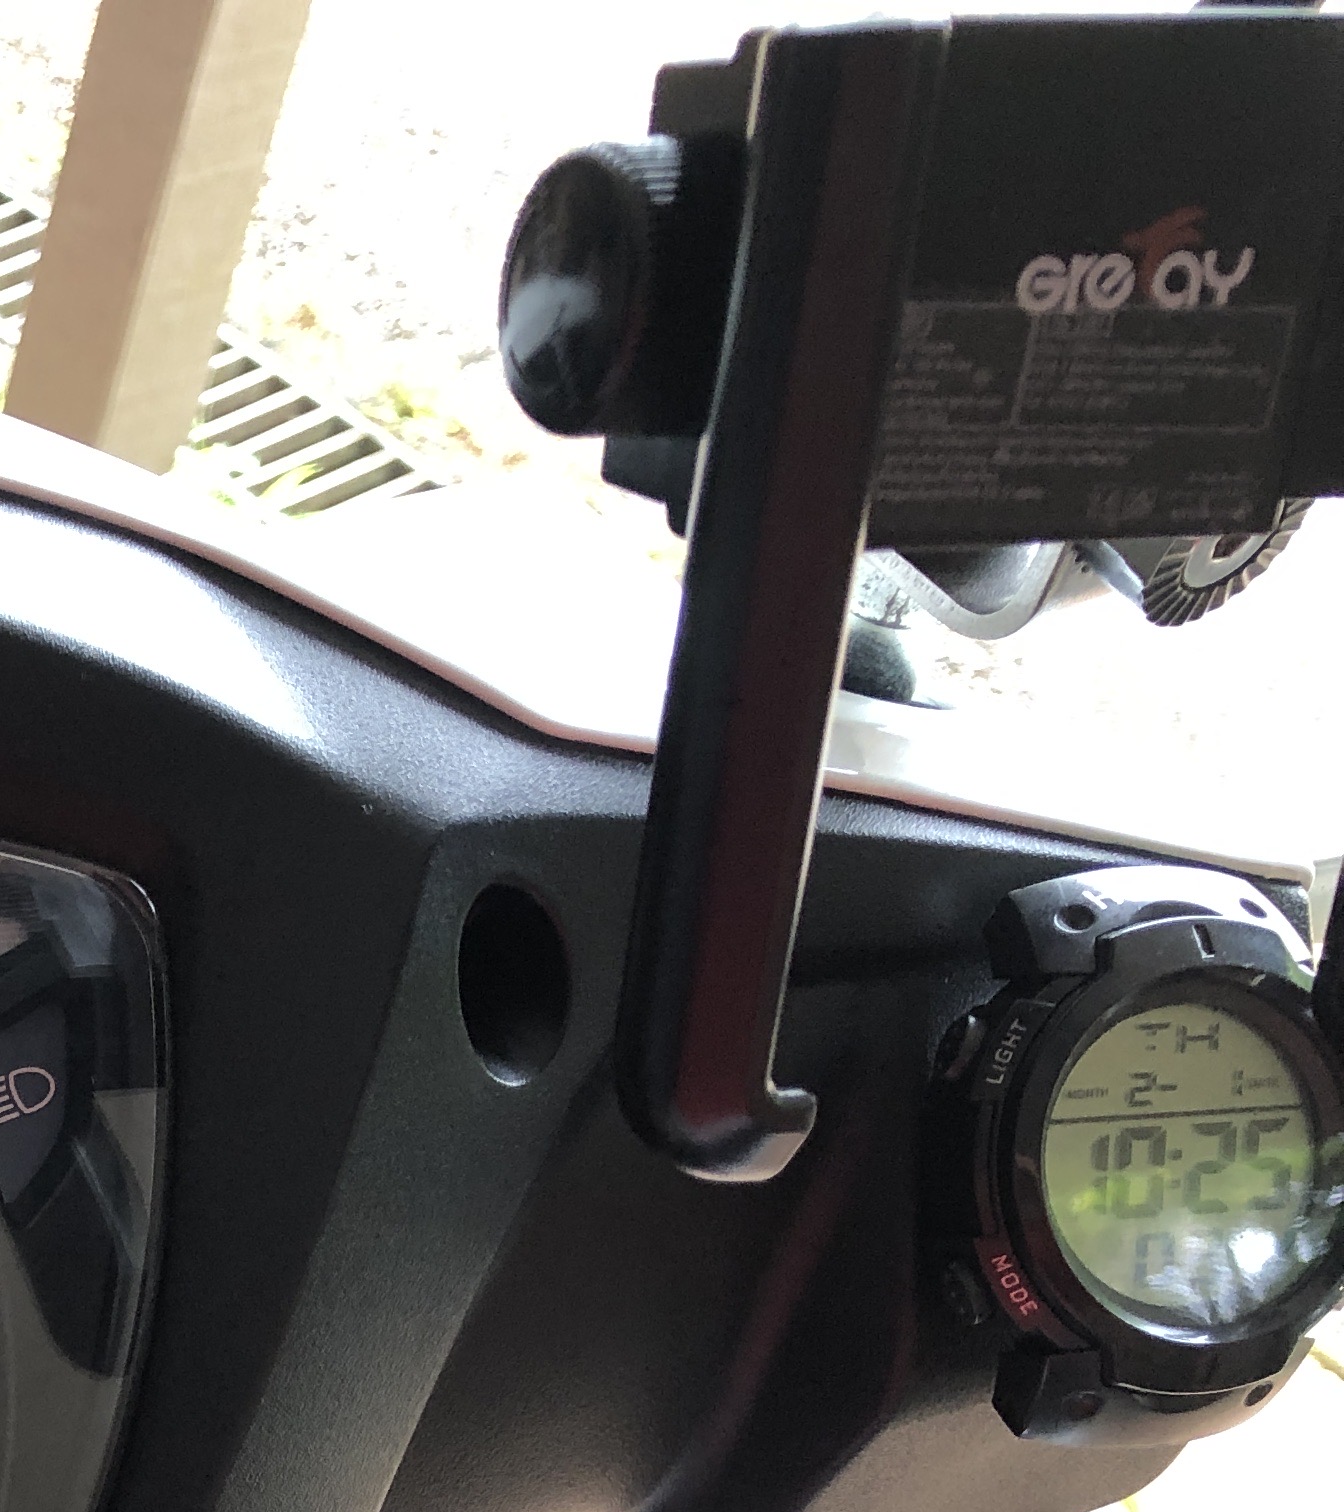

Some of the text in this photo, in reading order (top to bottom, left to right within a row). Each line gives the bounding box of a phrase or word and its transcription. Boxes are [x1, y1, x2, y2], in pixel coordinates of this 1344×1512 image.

[985, 1018, 1027, 1086] LIGHT
[1089, 1116, 1292, 1220] 10:25
[990, 1253, 1040, 1318] MODE
